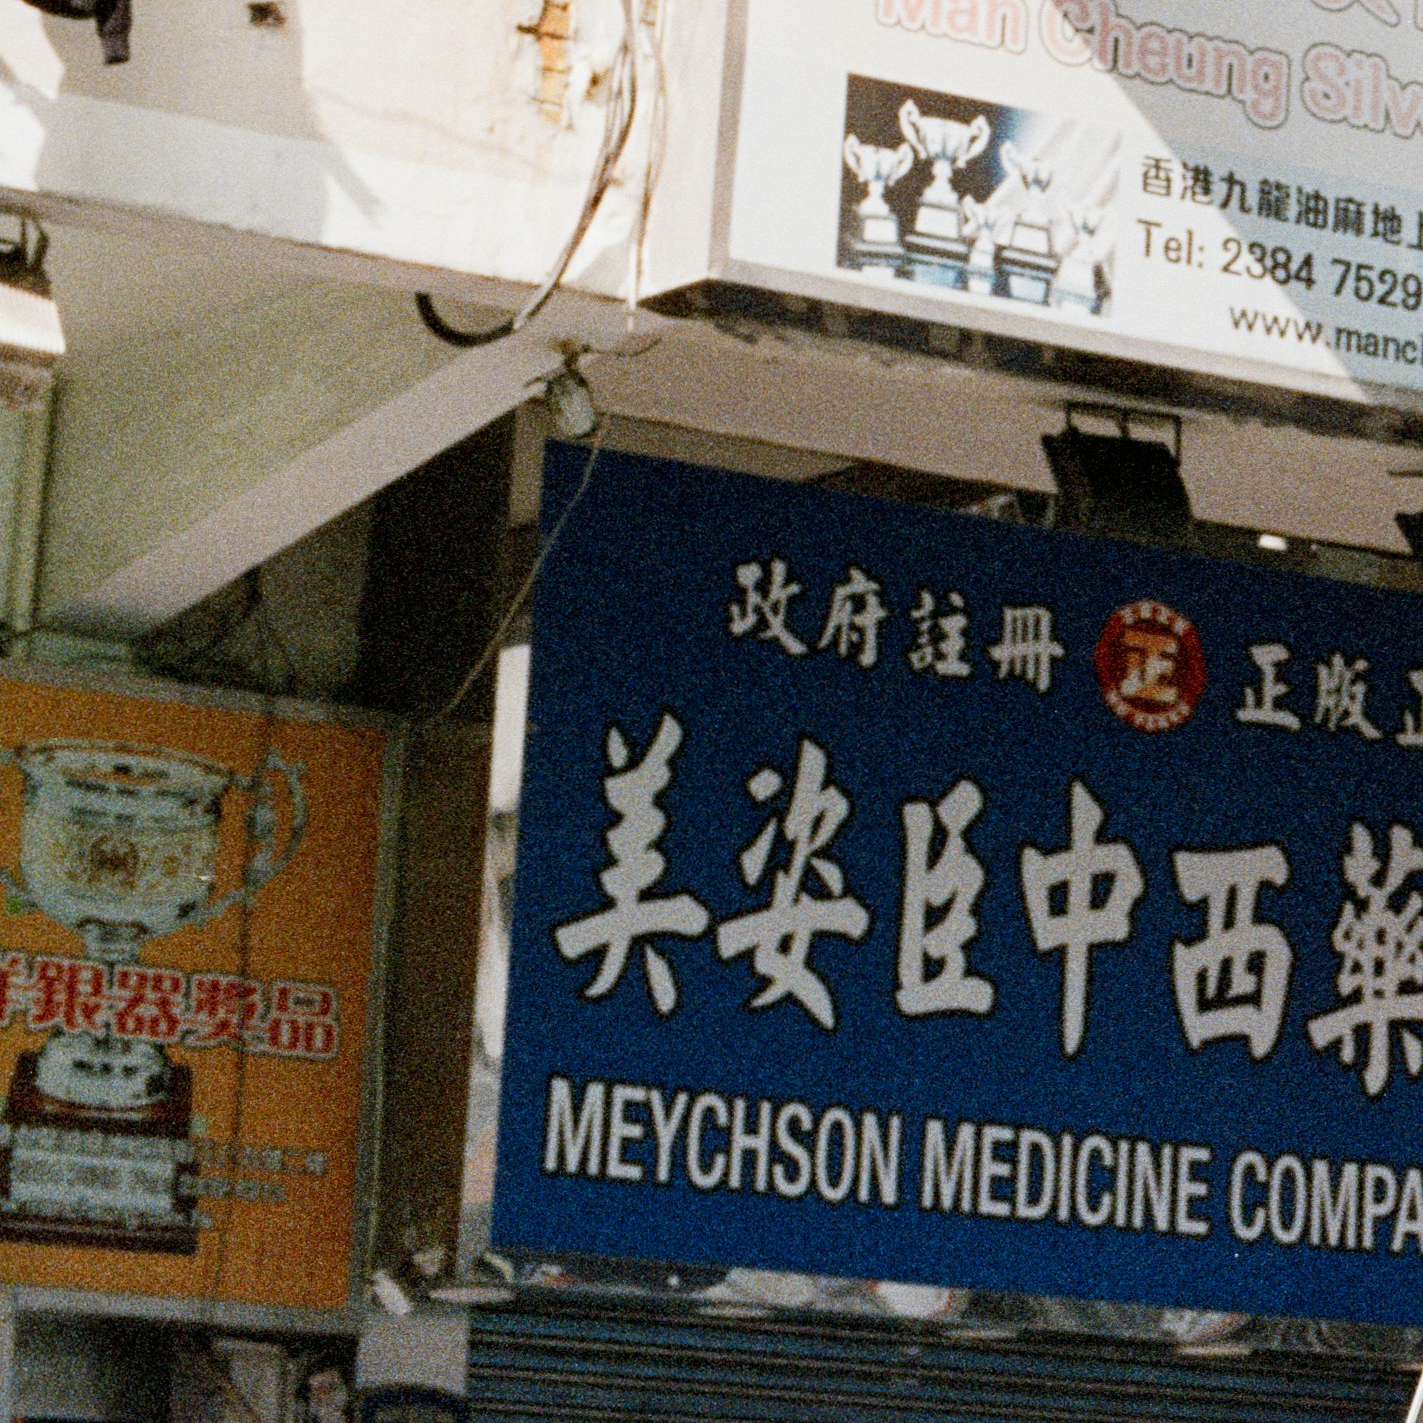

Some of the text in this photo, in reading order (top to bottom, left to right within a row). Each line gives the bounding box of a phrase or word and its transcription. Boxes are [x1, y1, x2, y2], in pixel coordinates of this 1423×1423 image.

[1136, 218, 1204, 269] Tel:
[1220, 237, 1316, 290] 2384
[1331, 257, 1423, 312] 7529
[725, 556, 1067, 696] 政府註冊
[543, 1074, 903, 1211] MEYCHSON
[919, 1117, 1212, 1237] MEDICINE
